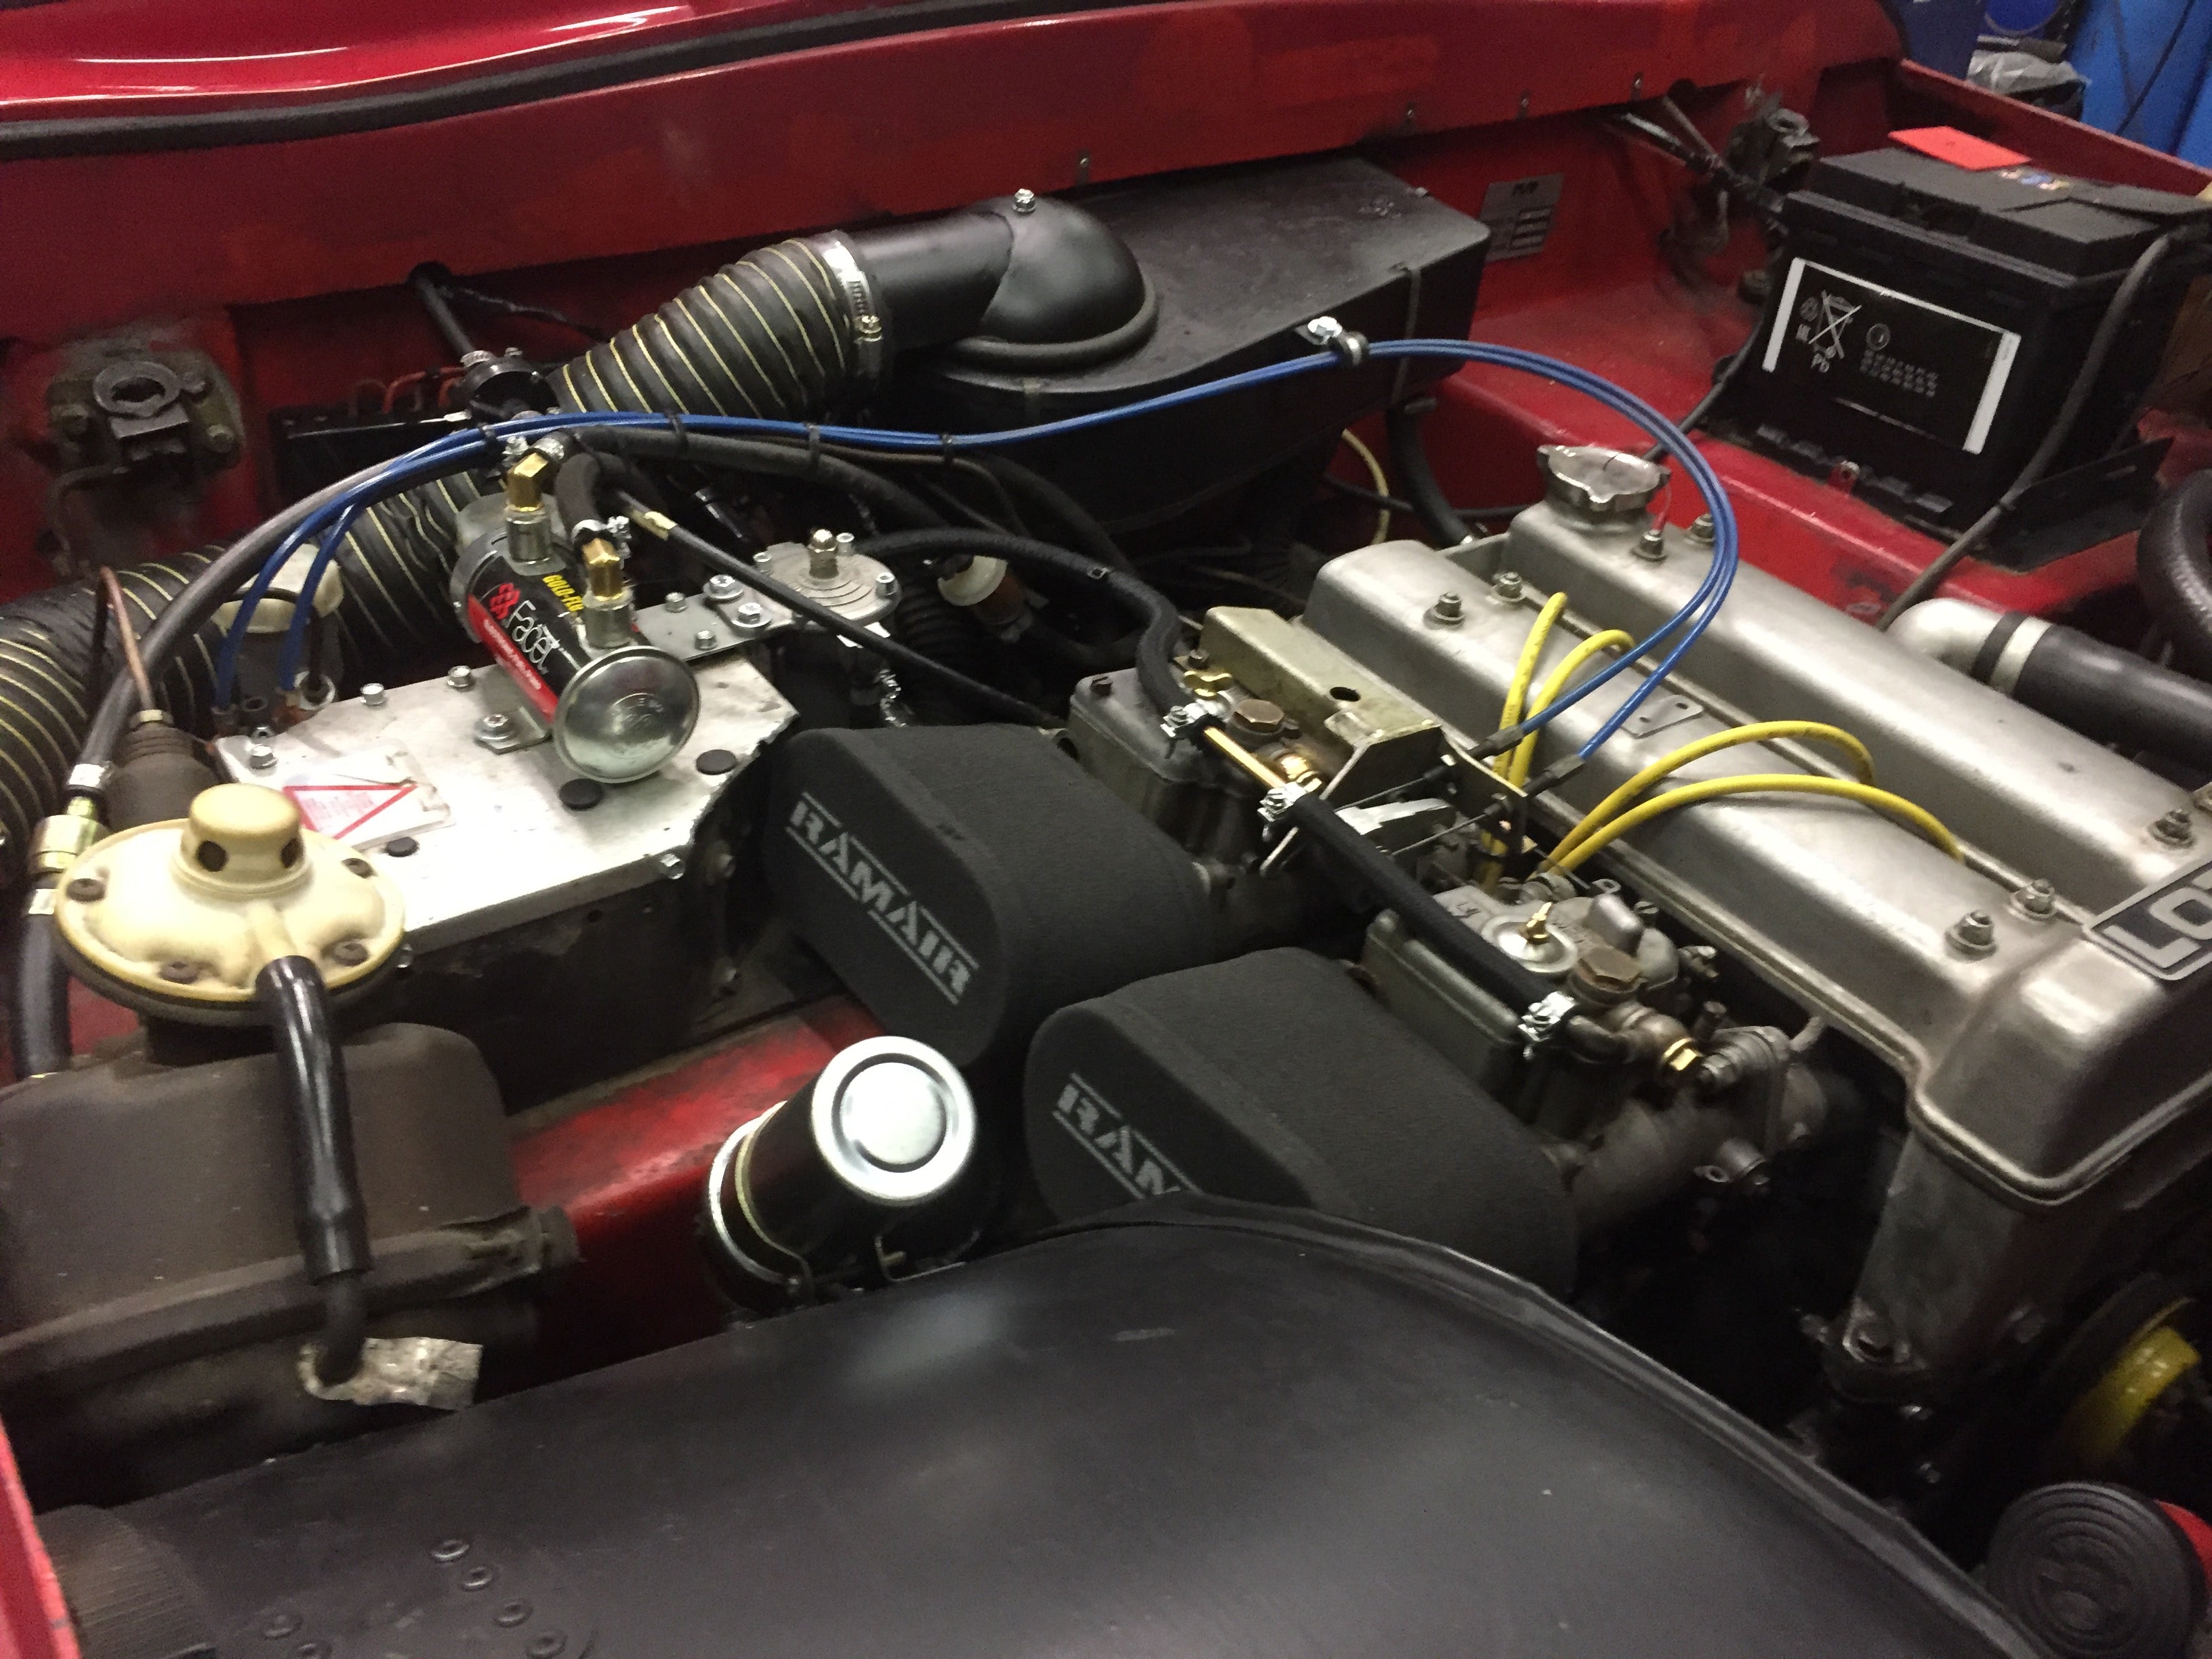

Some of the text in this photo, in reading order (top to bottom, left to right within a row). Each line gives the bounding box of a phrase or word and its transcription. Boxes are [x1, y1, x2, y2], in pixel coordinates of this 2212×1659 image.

[502, 600, 560, 674] Facet
[790, 800, 971, 994] RAMAIR
[2103, 868, 2212, 969] LO
